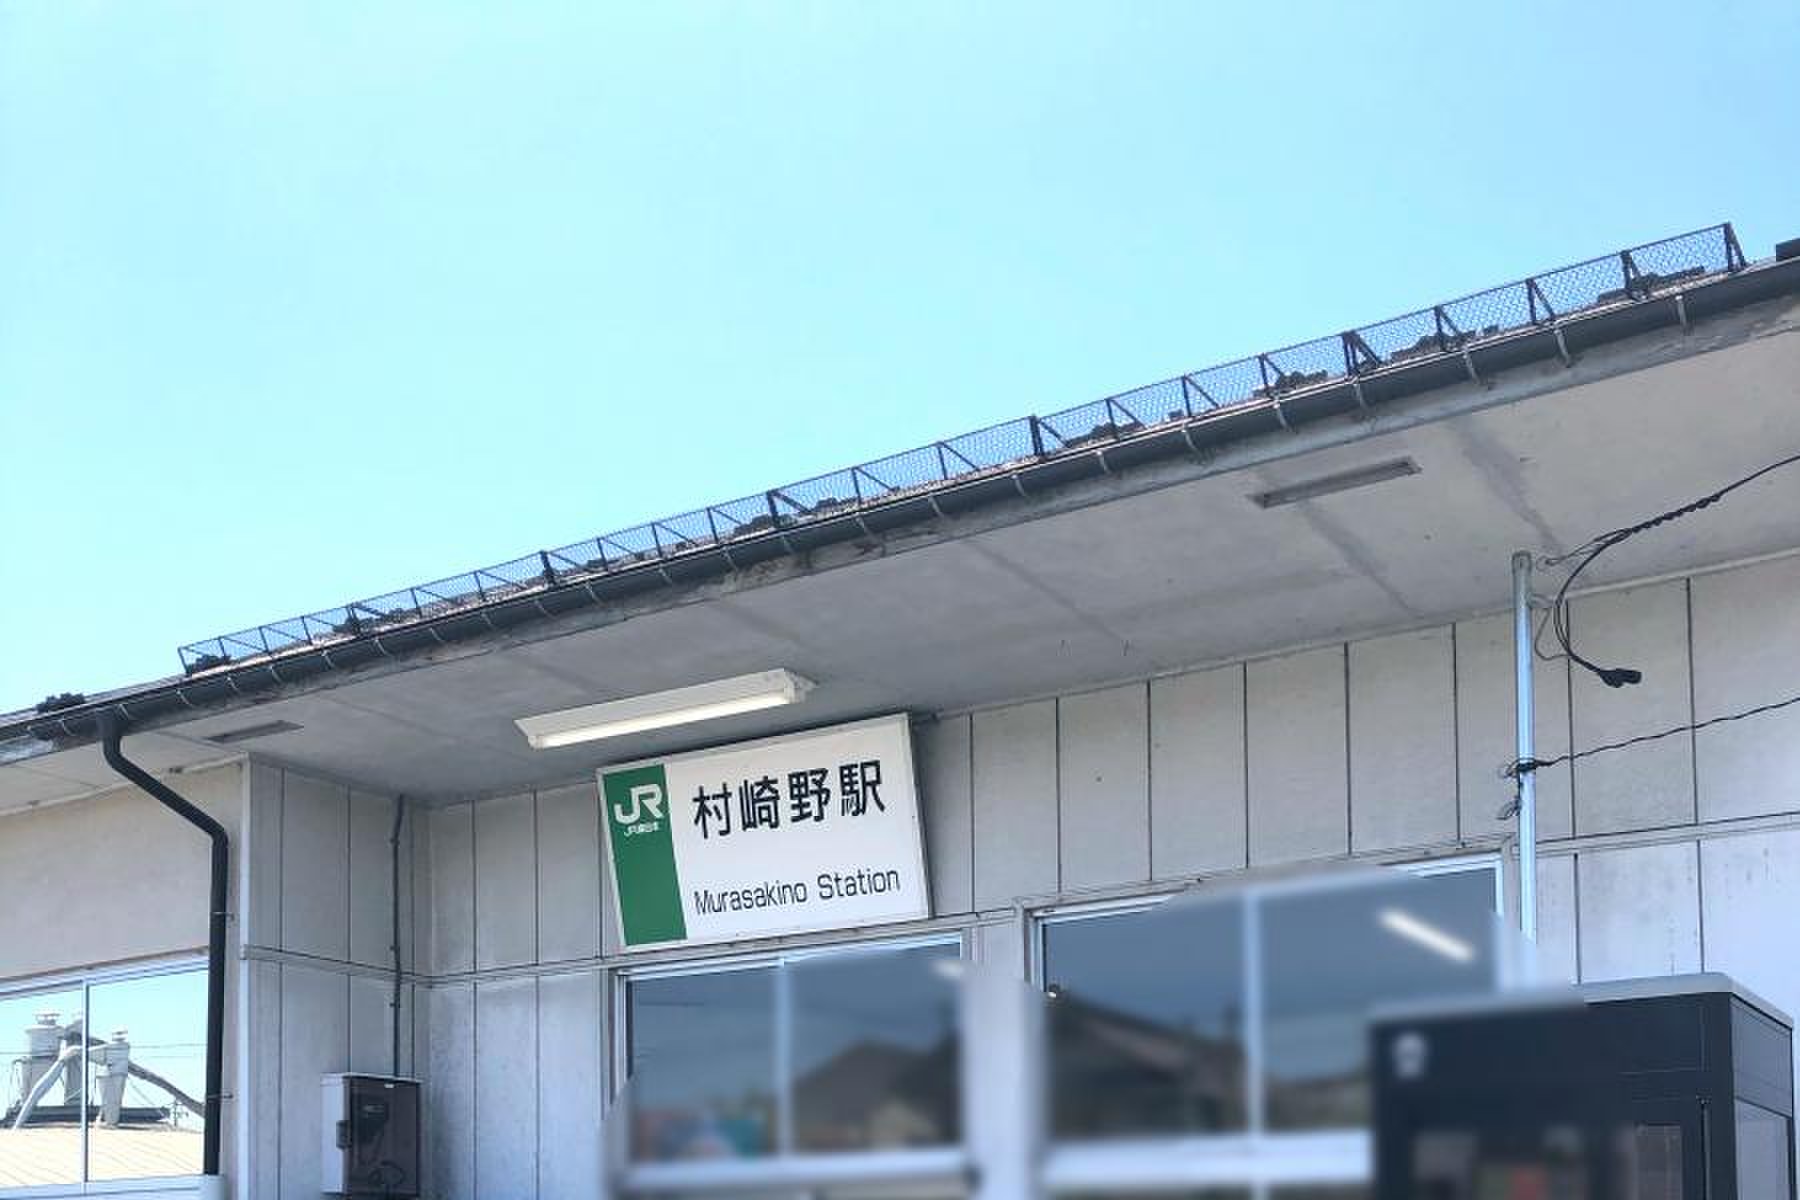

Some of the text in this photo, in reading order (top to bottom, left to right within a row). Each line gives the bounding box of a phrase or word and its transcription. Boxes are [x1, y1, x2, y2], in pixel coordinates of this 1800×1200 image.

[614, 784, 664, 824] JR
[692, 759, 886, 839] 村崎野駅
[694, 867, 901, 915] Murasakino Station
